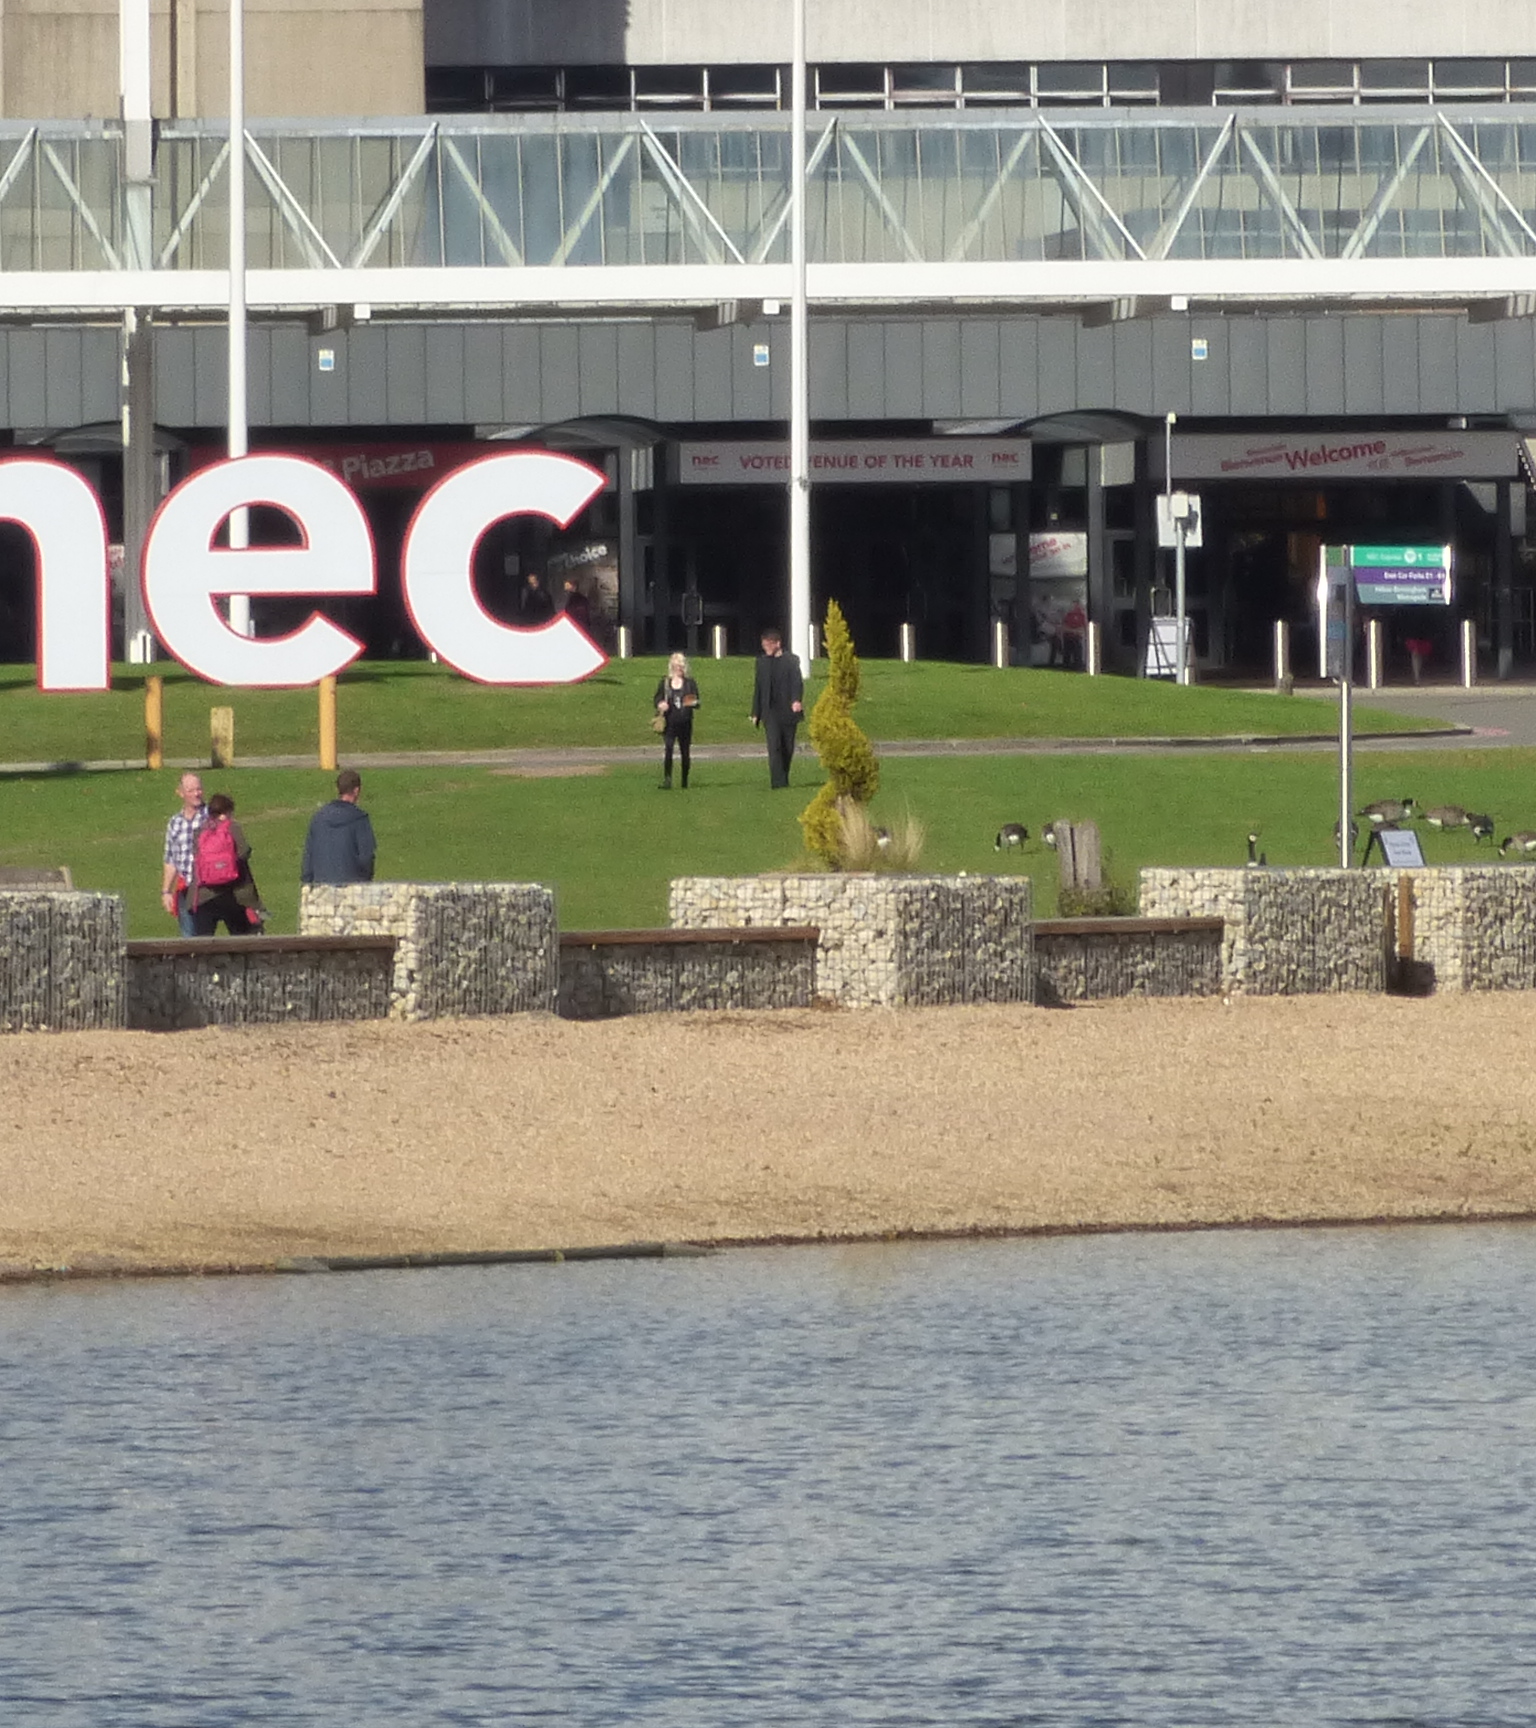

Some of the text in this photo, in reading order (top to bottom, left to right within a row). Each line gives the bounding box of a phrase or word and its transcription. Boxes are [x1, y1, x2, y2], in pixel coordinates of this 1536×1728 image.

[342, 450, 435, 483] Piazza
[865, 455, 887, 469] OF
[894, 455, 924, 469] THE
[930, 455, 974, 469] YEAR
[1285, 440, 1386, 471] Welcome
